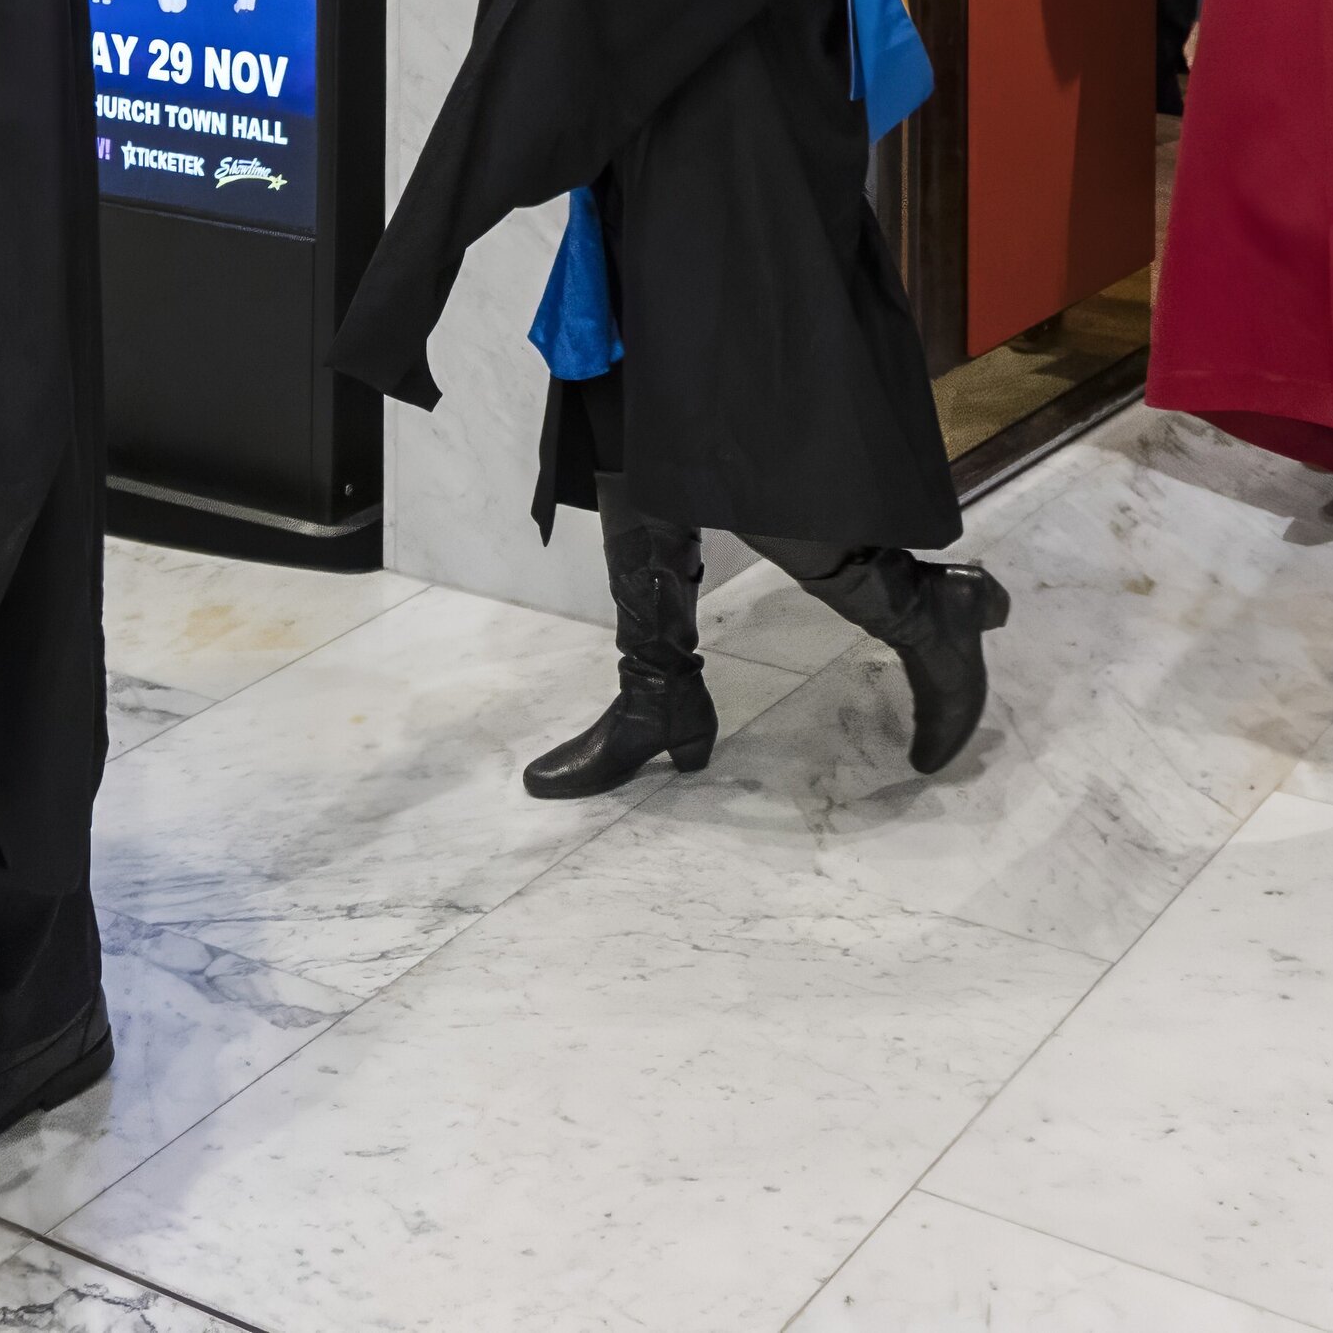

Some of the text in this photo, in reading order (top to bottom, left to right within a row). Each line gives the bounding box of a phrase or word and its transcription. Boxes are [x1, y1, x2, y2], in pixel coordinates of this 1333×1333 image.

[147, 39, 193, 84] 29
[204, 46, 289, 97] NOV
[165, 104, 227, 136] TOWN
[232, 115, 289, 145] HALL
[136, 147, 205, 177] TICKETEK
